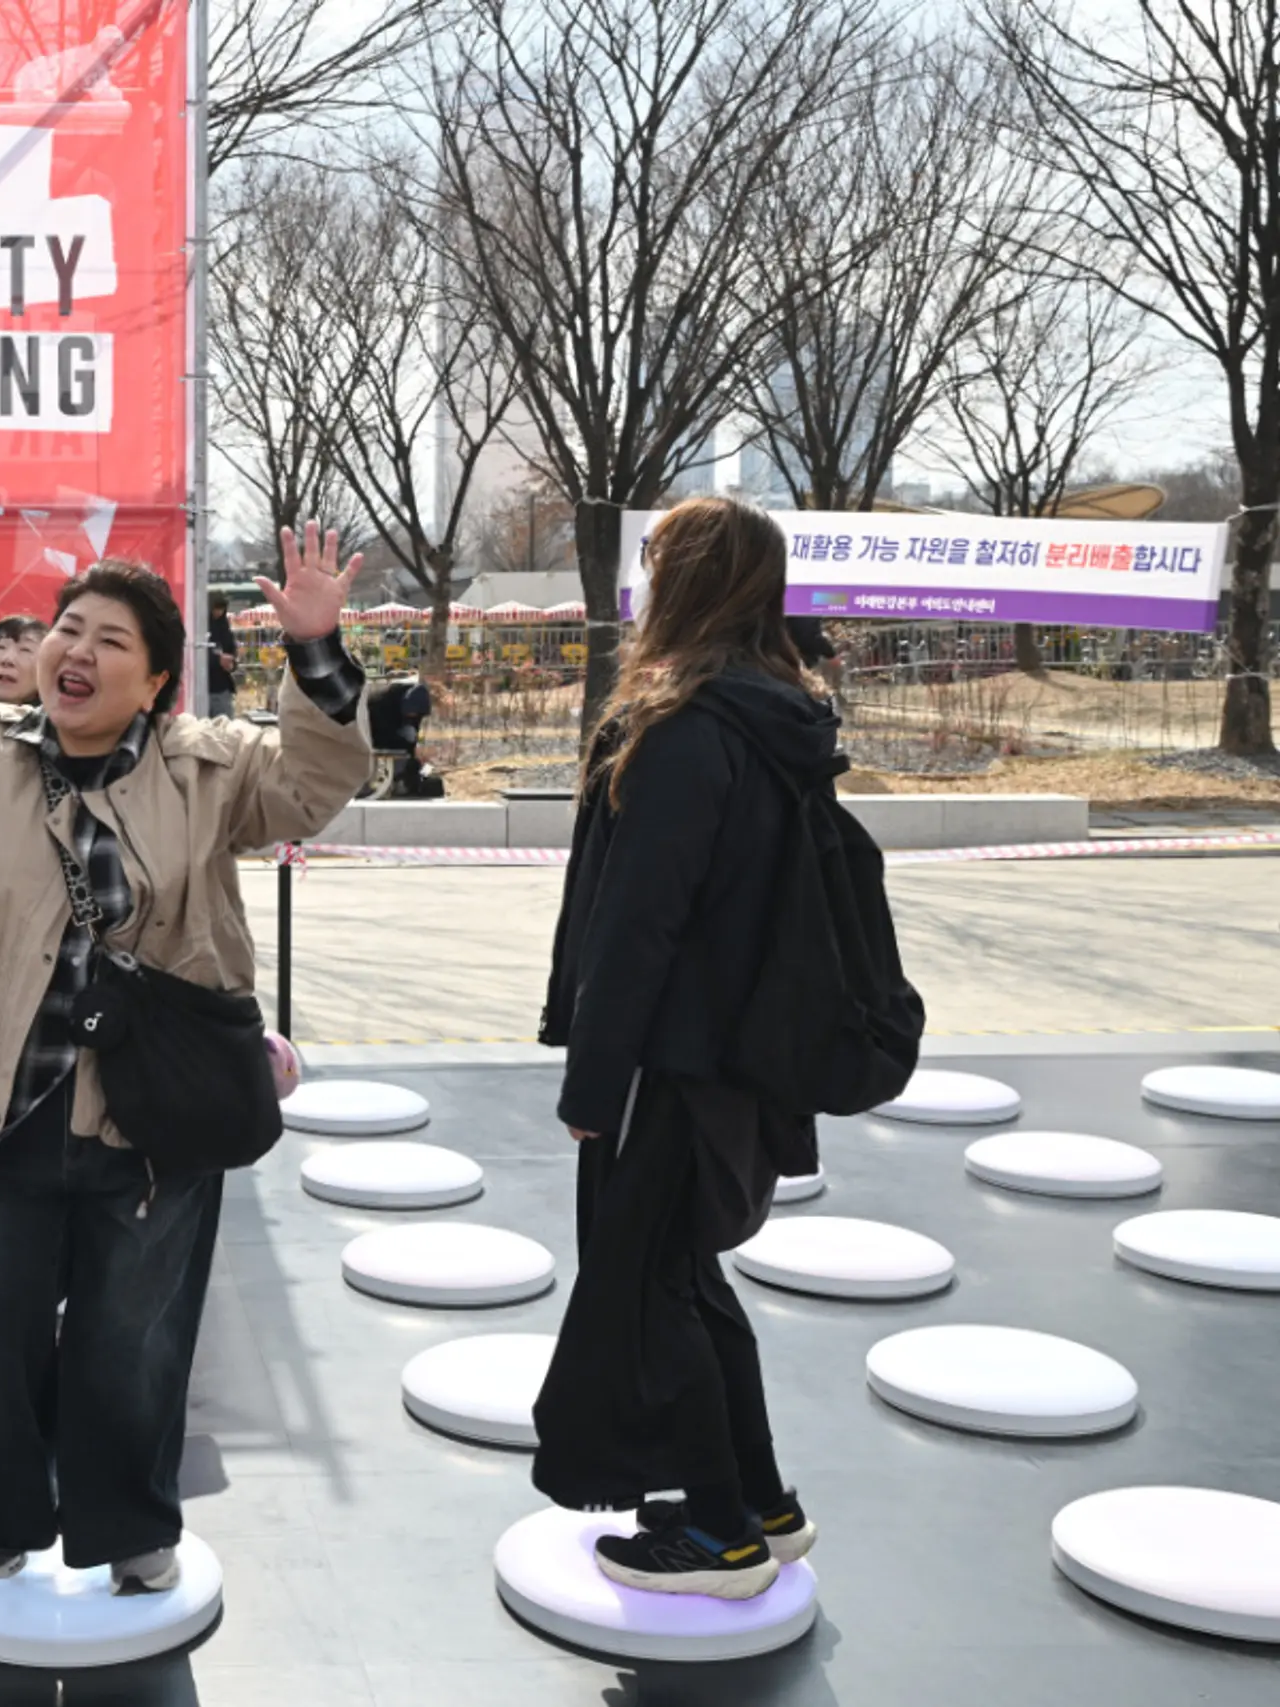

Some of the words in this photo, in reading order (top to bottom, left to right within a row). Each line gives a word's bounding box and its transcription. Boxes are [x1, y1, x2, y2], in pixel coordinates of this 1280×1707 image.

[789, 533, 853, 563] 재활용
[858, 535, 901, 564] 가능
[905, 537, 971, 566] 자원을
[974, 539, 1043, 568] 철저히
[1044, 542, 1203, 574] 분리배출합시다
